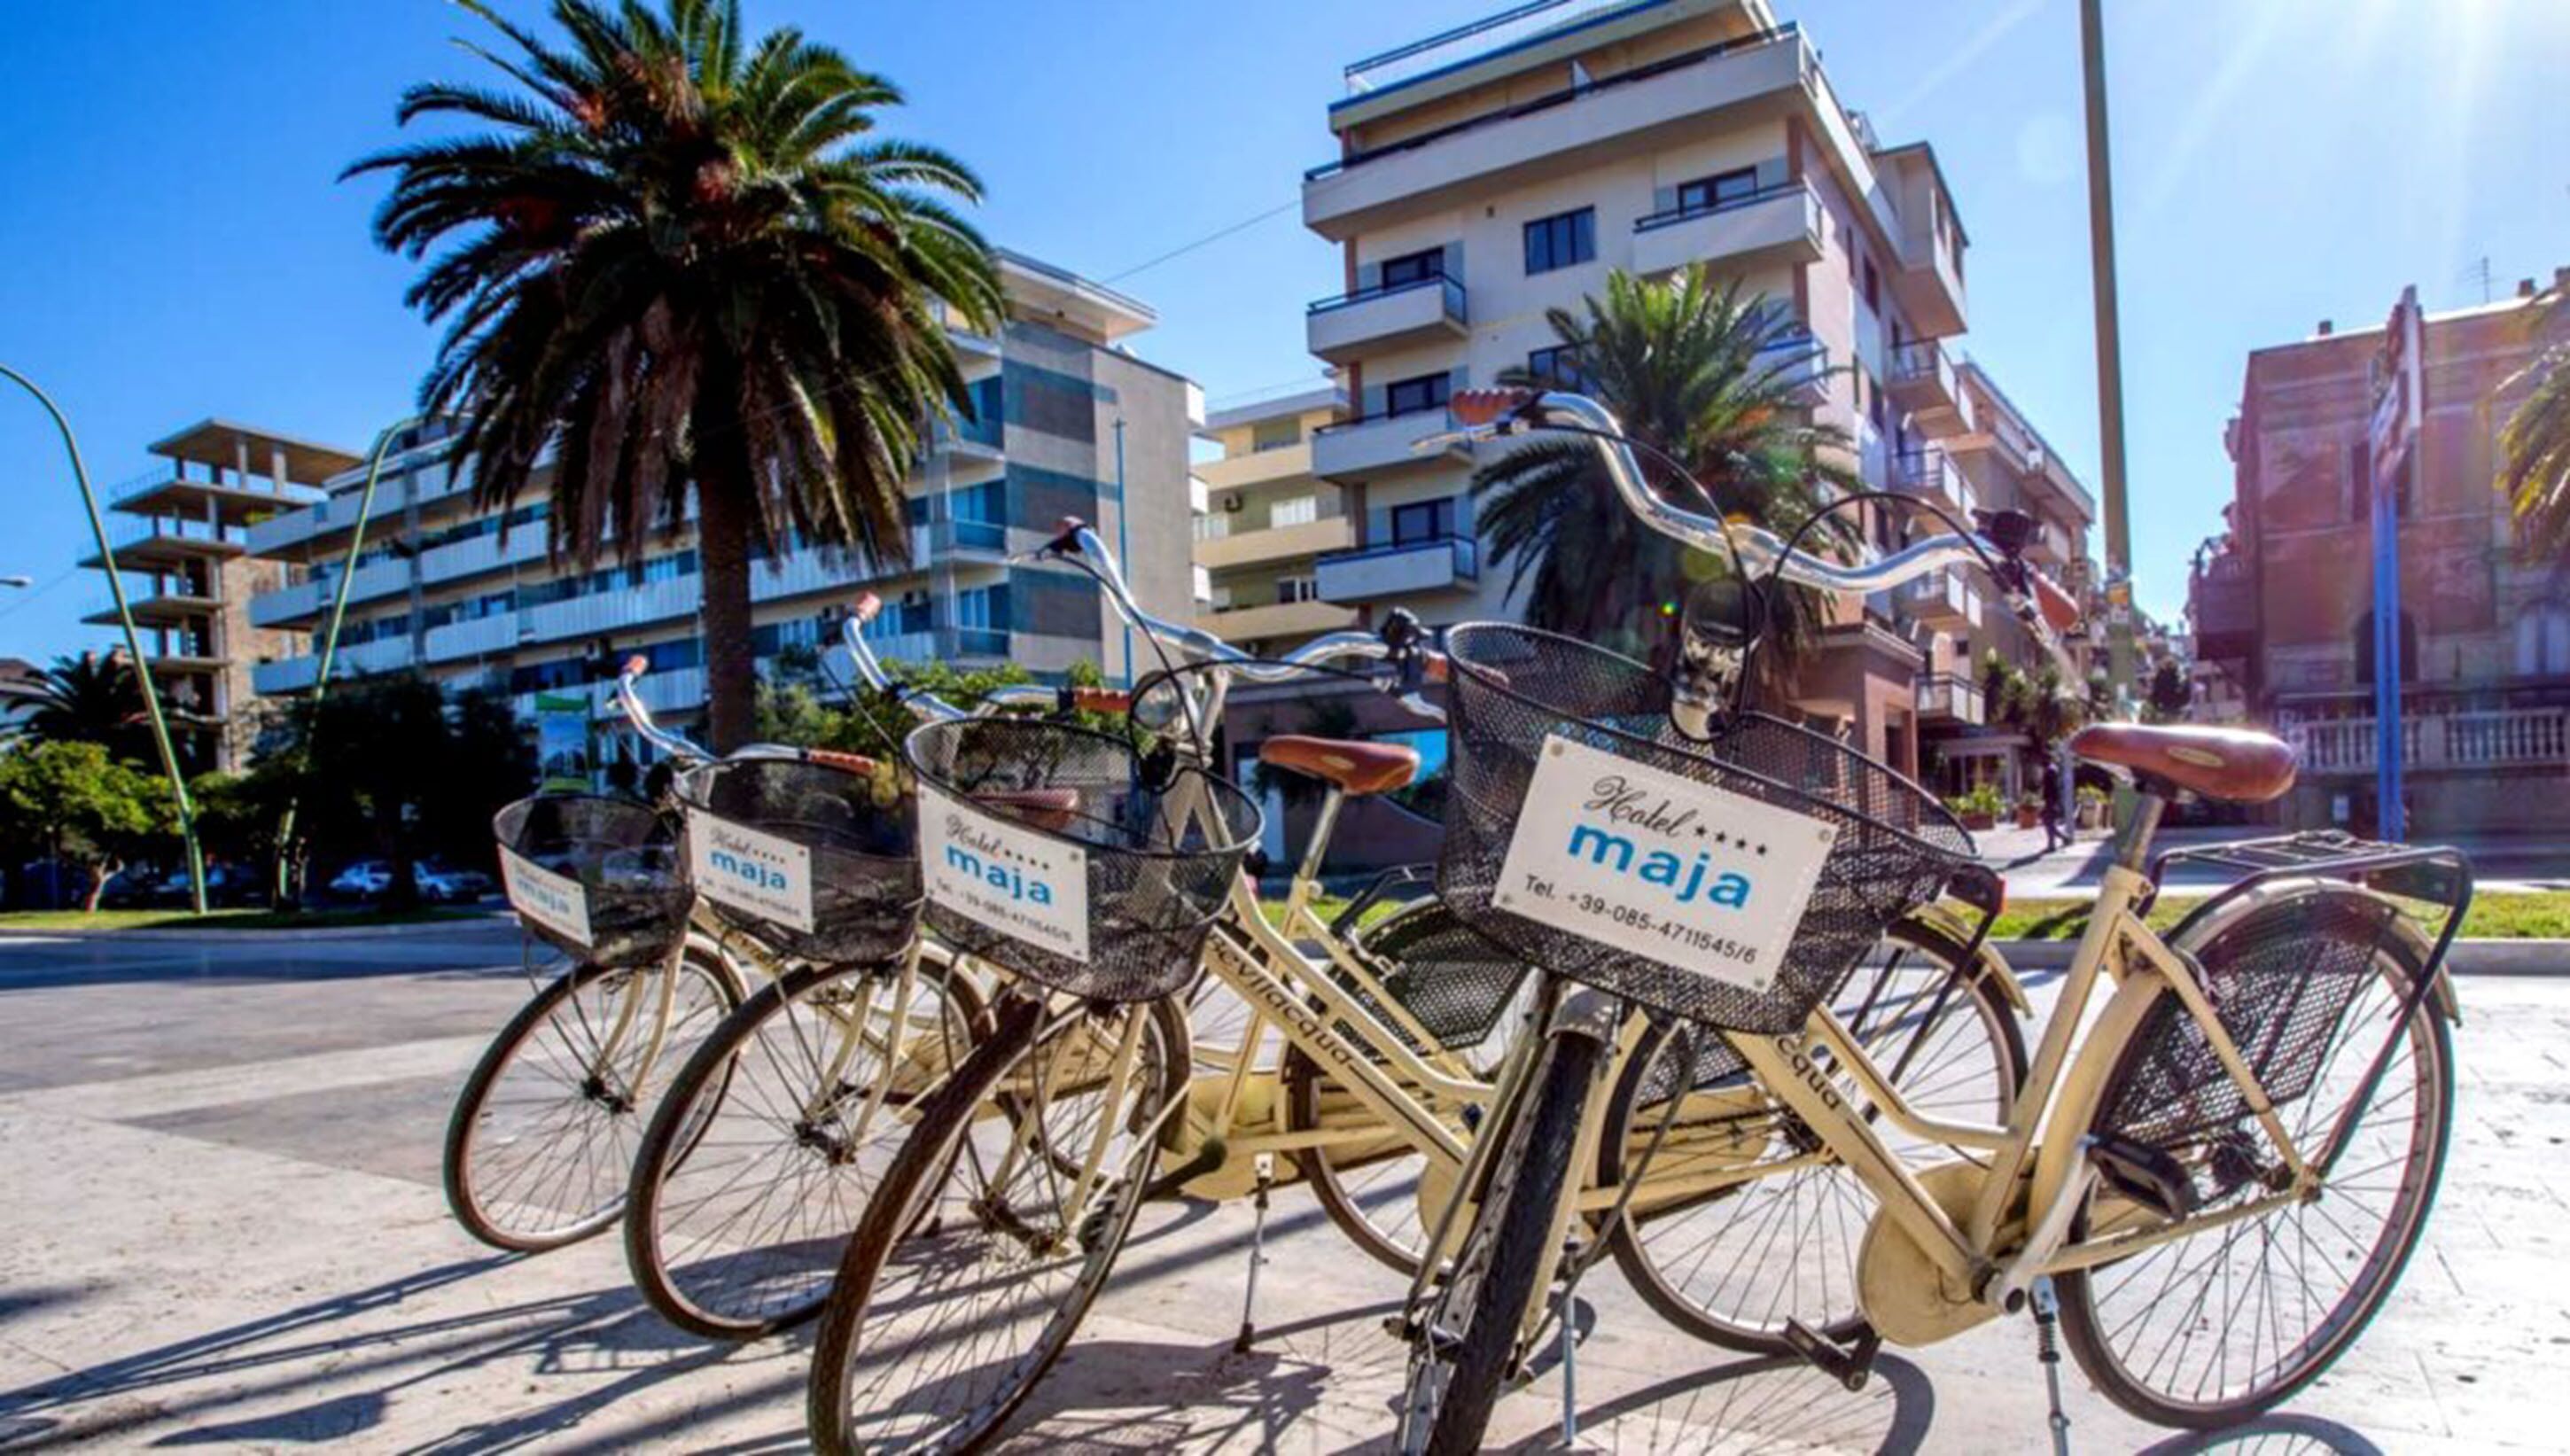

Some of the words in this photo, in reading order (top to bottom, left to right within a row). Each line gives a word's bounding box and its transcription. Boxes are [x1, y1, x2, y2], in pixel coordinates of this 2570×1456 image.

[1583, 775, 1696, 838] Hotel
[710, 850, 787, 891] maja
[946, 845, 1052, 906] maja
[1567, 823, 1751, 909] maja
[1525, 874, 1555, 900] Tel.
[1568, 892, 1759, 964] +39-085-4711545/6
